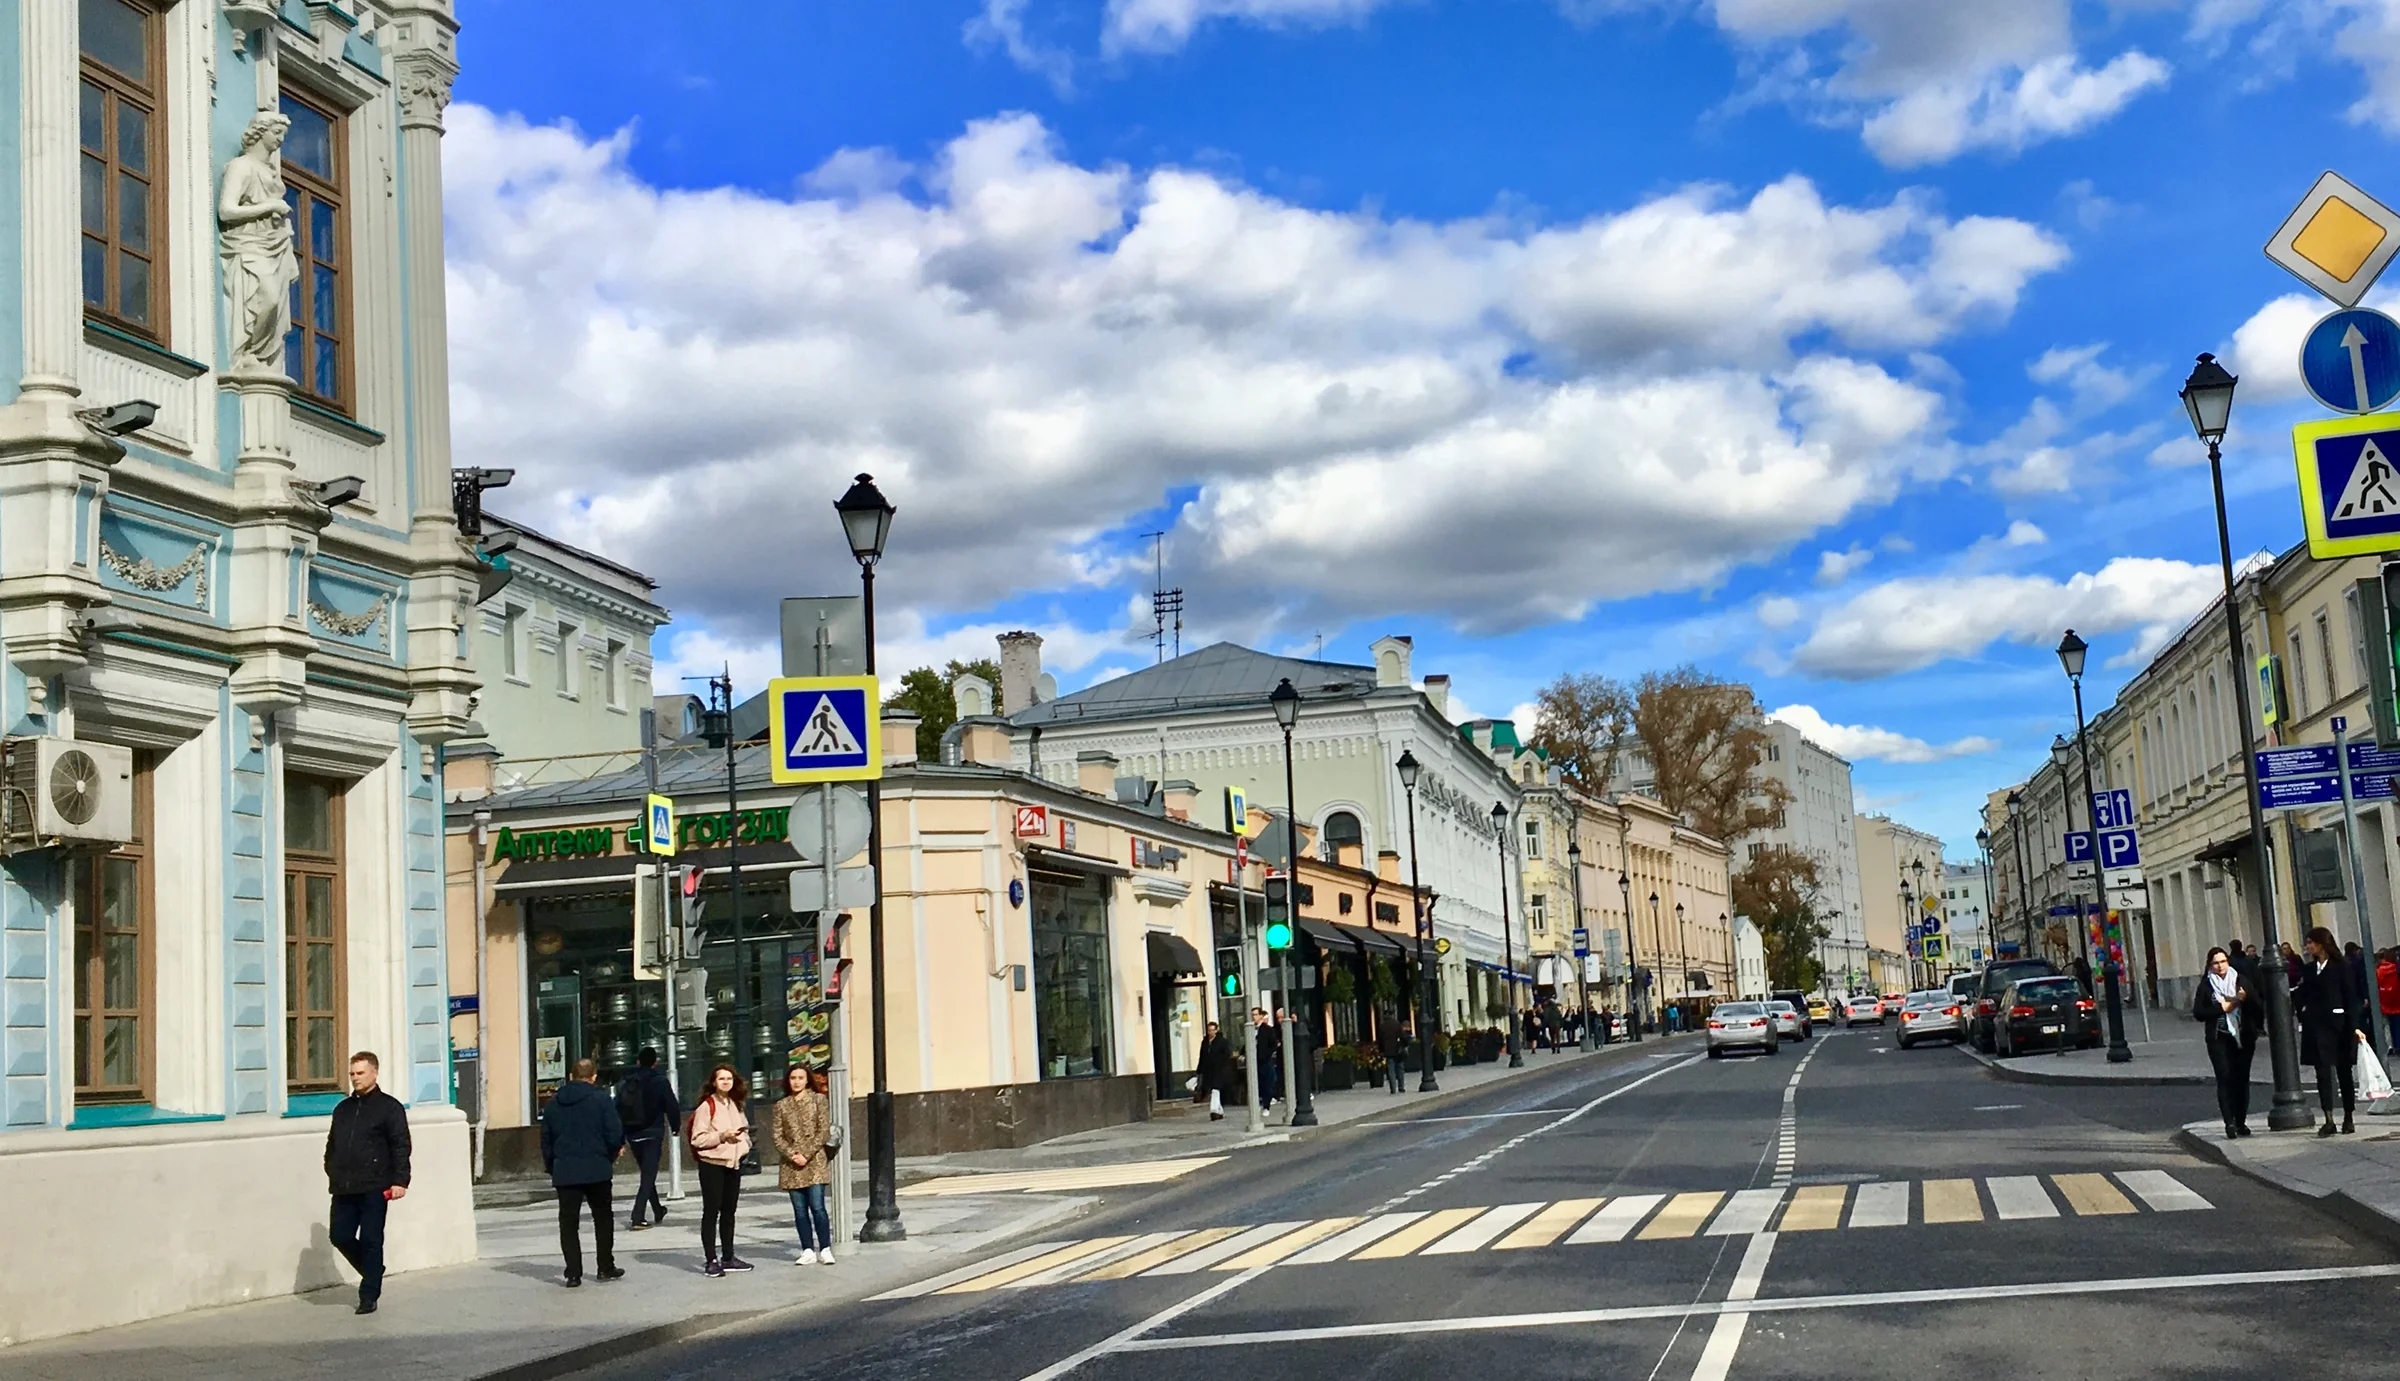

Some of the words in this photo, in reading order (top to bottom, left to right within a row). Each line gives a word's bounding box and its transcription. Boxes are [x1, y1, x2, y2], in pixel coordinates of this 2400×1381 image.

[1019, 808, 1045, 835] 24
[494, 826, 613, 860] Аптеки
[2071, 835, 2088, 858] P
[2107, 834, 2130, 864] P
